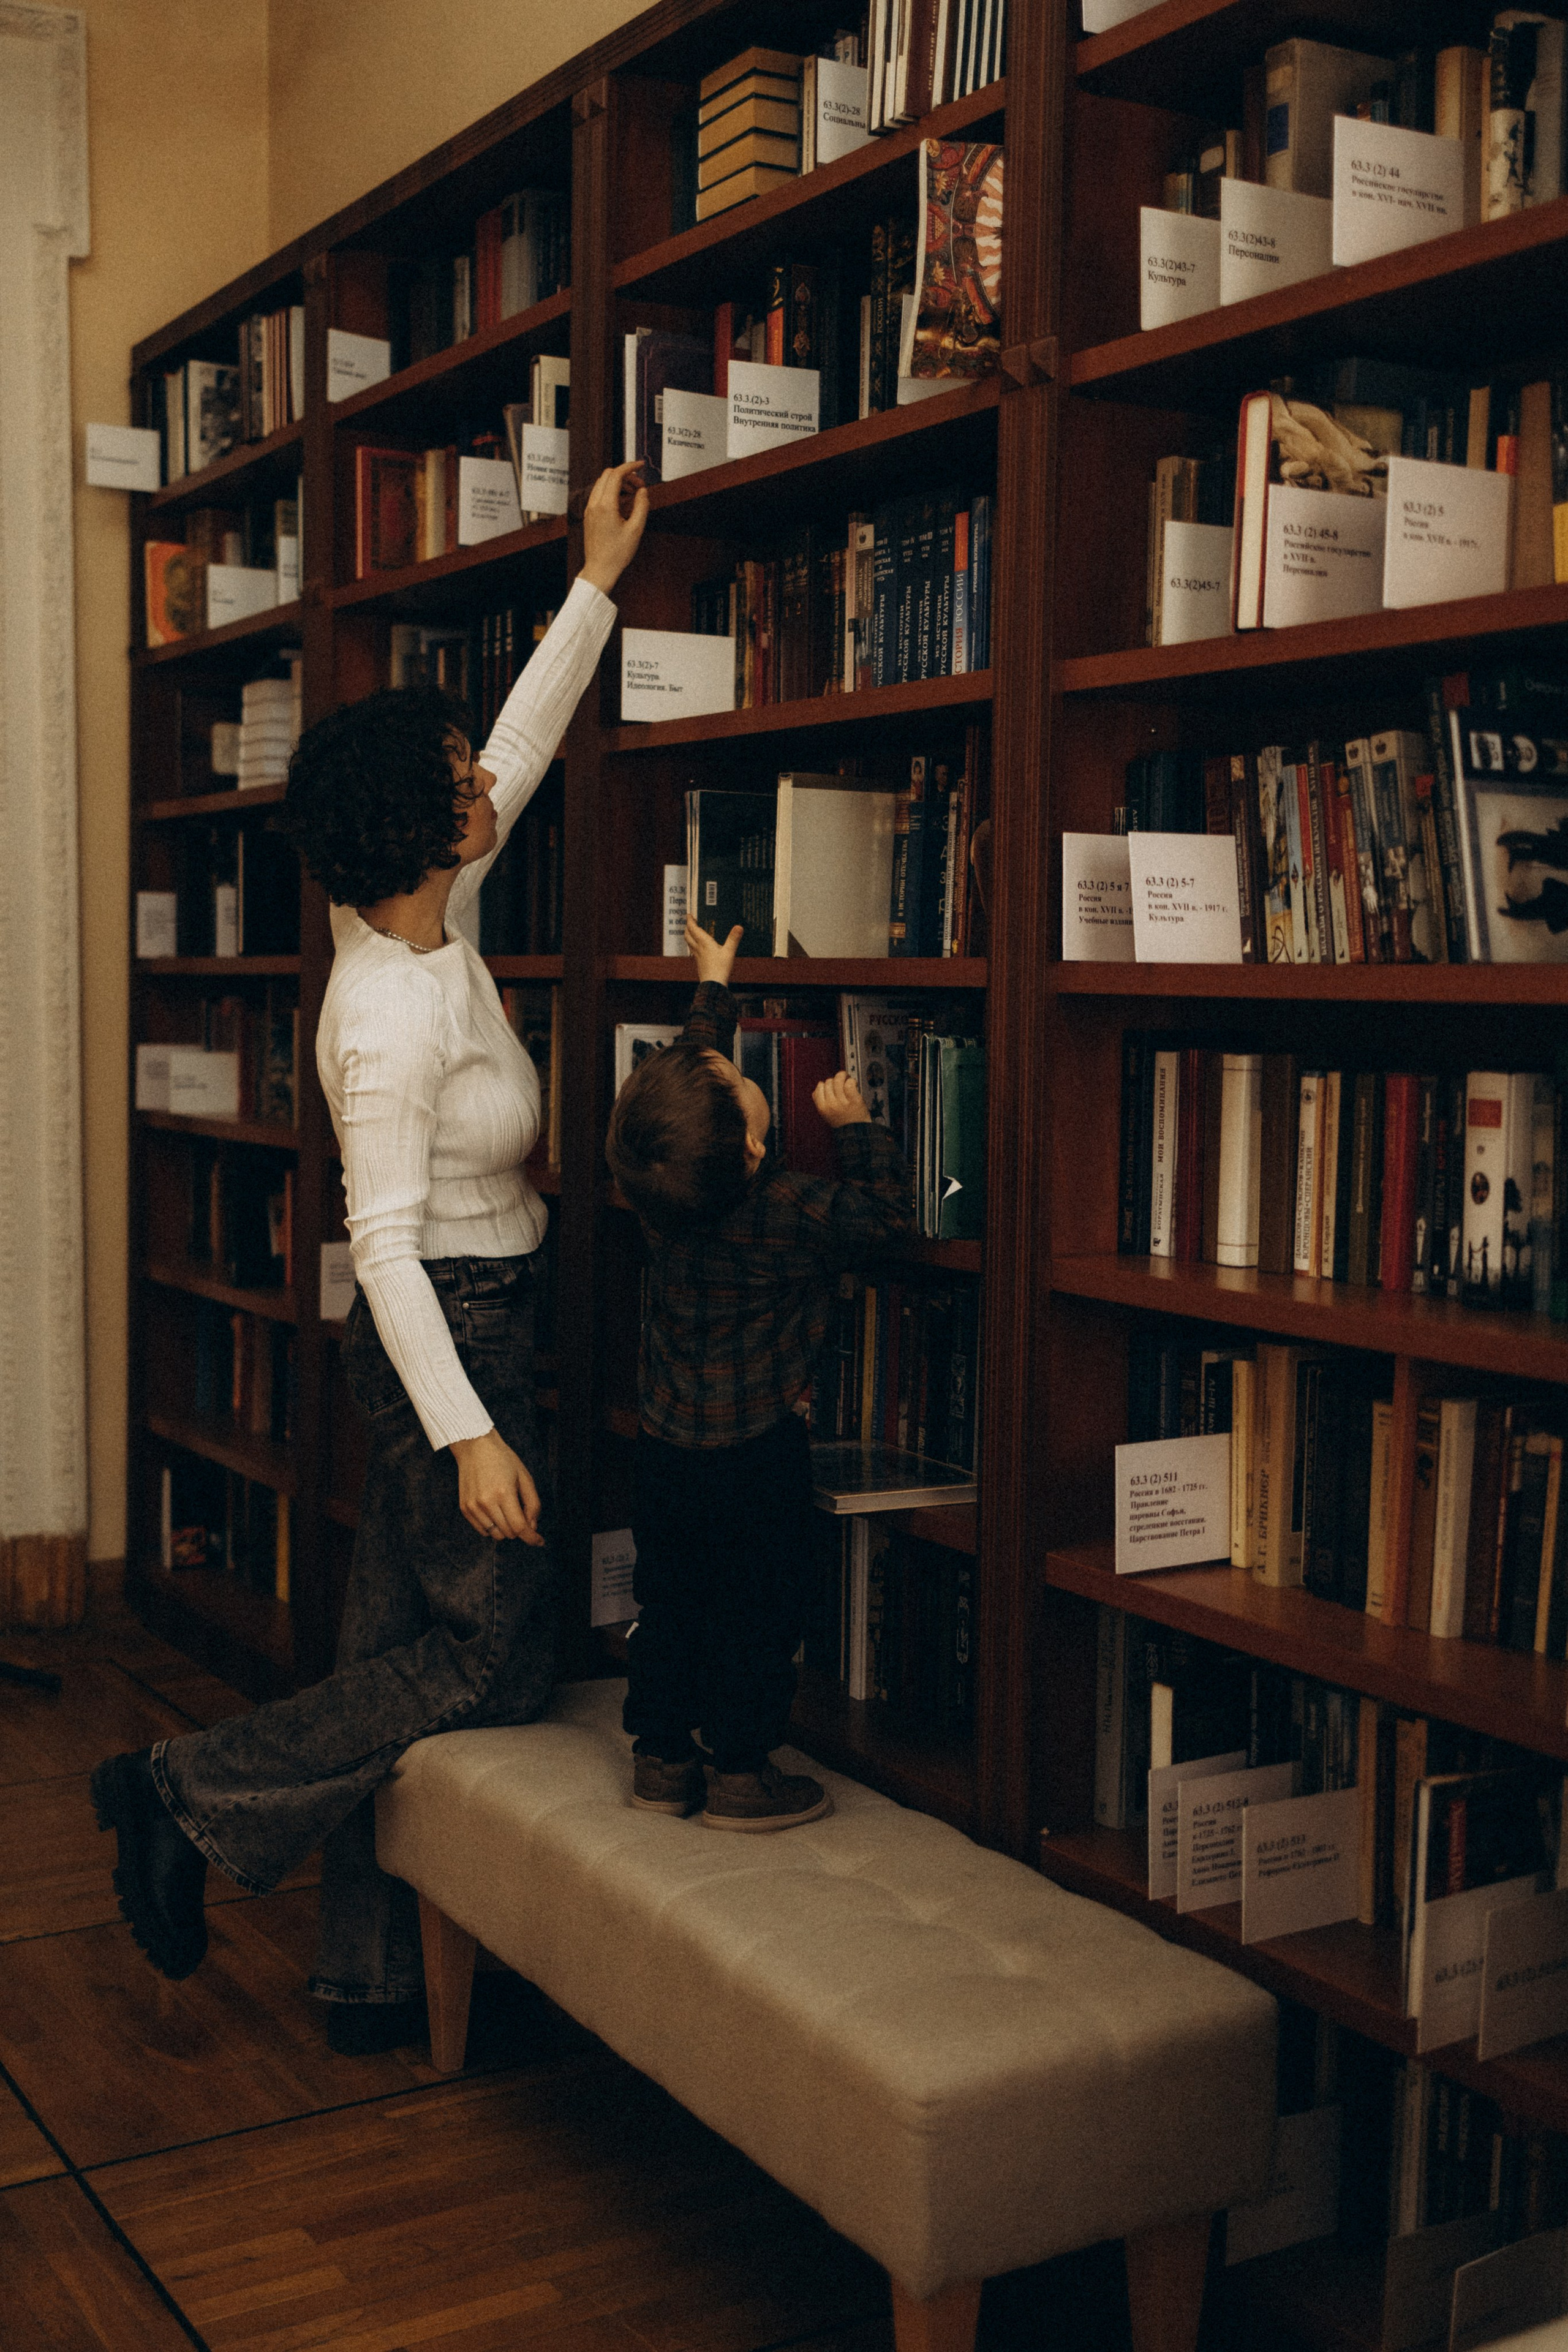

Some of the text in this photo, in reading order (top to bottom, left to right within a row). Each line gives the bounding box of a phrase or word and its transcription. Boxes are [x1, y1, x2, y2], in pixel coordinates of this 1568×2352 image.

[823, 100, 861, 116] 63.3(2)-28
[1351, 160, 1400, 178] 63.3 (2) 44
[1352, 175, 1395, 191] Российское
[1229, 230, 1276, 248] 63.3(2)43-8
[1229, 245, 1280, 264] Персоналии
[1148, 257, 1195, 273] 63.3(2)43-7
[1148, 271, 1187, 287] Культура
[734, 405, 813, 422] Политический строй
[734, 416, 816, 432] Внутренняя политика
[668, 437, 705, 449] Казачество
[1438, 505, 1444, 517] 5
[1171, 578, 1220, 592] 63.3(2)45-7
[954, 573, 964, 674] СТОРИЯ РОССИИ
[627, 671, 660, 681] Культура
[1311, 797, 1320, 854] ИСКУССТВЕ
[1077, 881, 1094, 891] 63.3
[1096, 881, 1107, 892] (2)
[1110, 883, 1115, 891] 5
[1125, 882, 1129, 892] 7
[1145, 876, 1195, 889] 63.3 (2) 5-7
[1314, 856, 1324, 903] РУССКОМ
[1147, 891, 1173, 899] Россия
[1172, 903, 1189, 911] XVII
[1205, 904, 1220, 913] 1917
[1079, 916, 1108, 925] Учебные
[1148, 913, 1185, 924] Культура
[1130, 1472, 1177, 1486] 63.3 (2) 511
[1183, 1483, 1197, 1492] 1725
[1131, 1499, 1168, 1510] Правление
[1129, 1512, 1159, 1521] царевны
[1129, 1522, 1168, 1532] стрелецкие
[1129, 1531, 1178, 1544] Царствование
[1180, 1528, 1200, 1537] Петра
[1257, 1562, 1266, 1575] А.
[1193, 1802, 1224, 1816] 63.3 (2)
